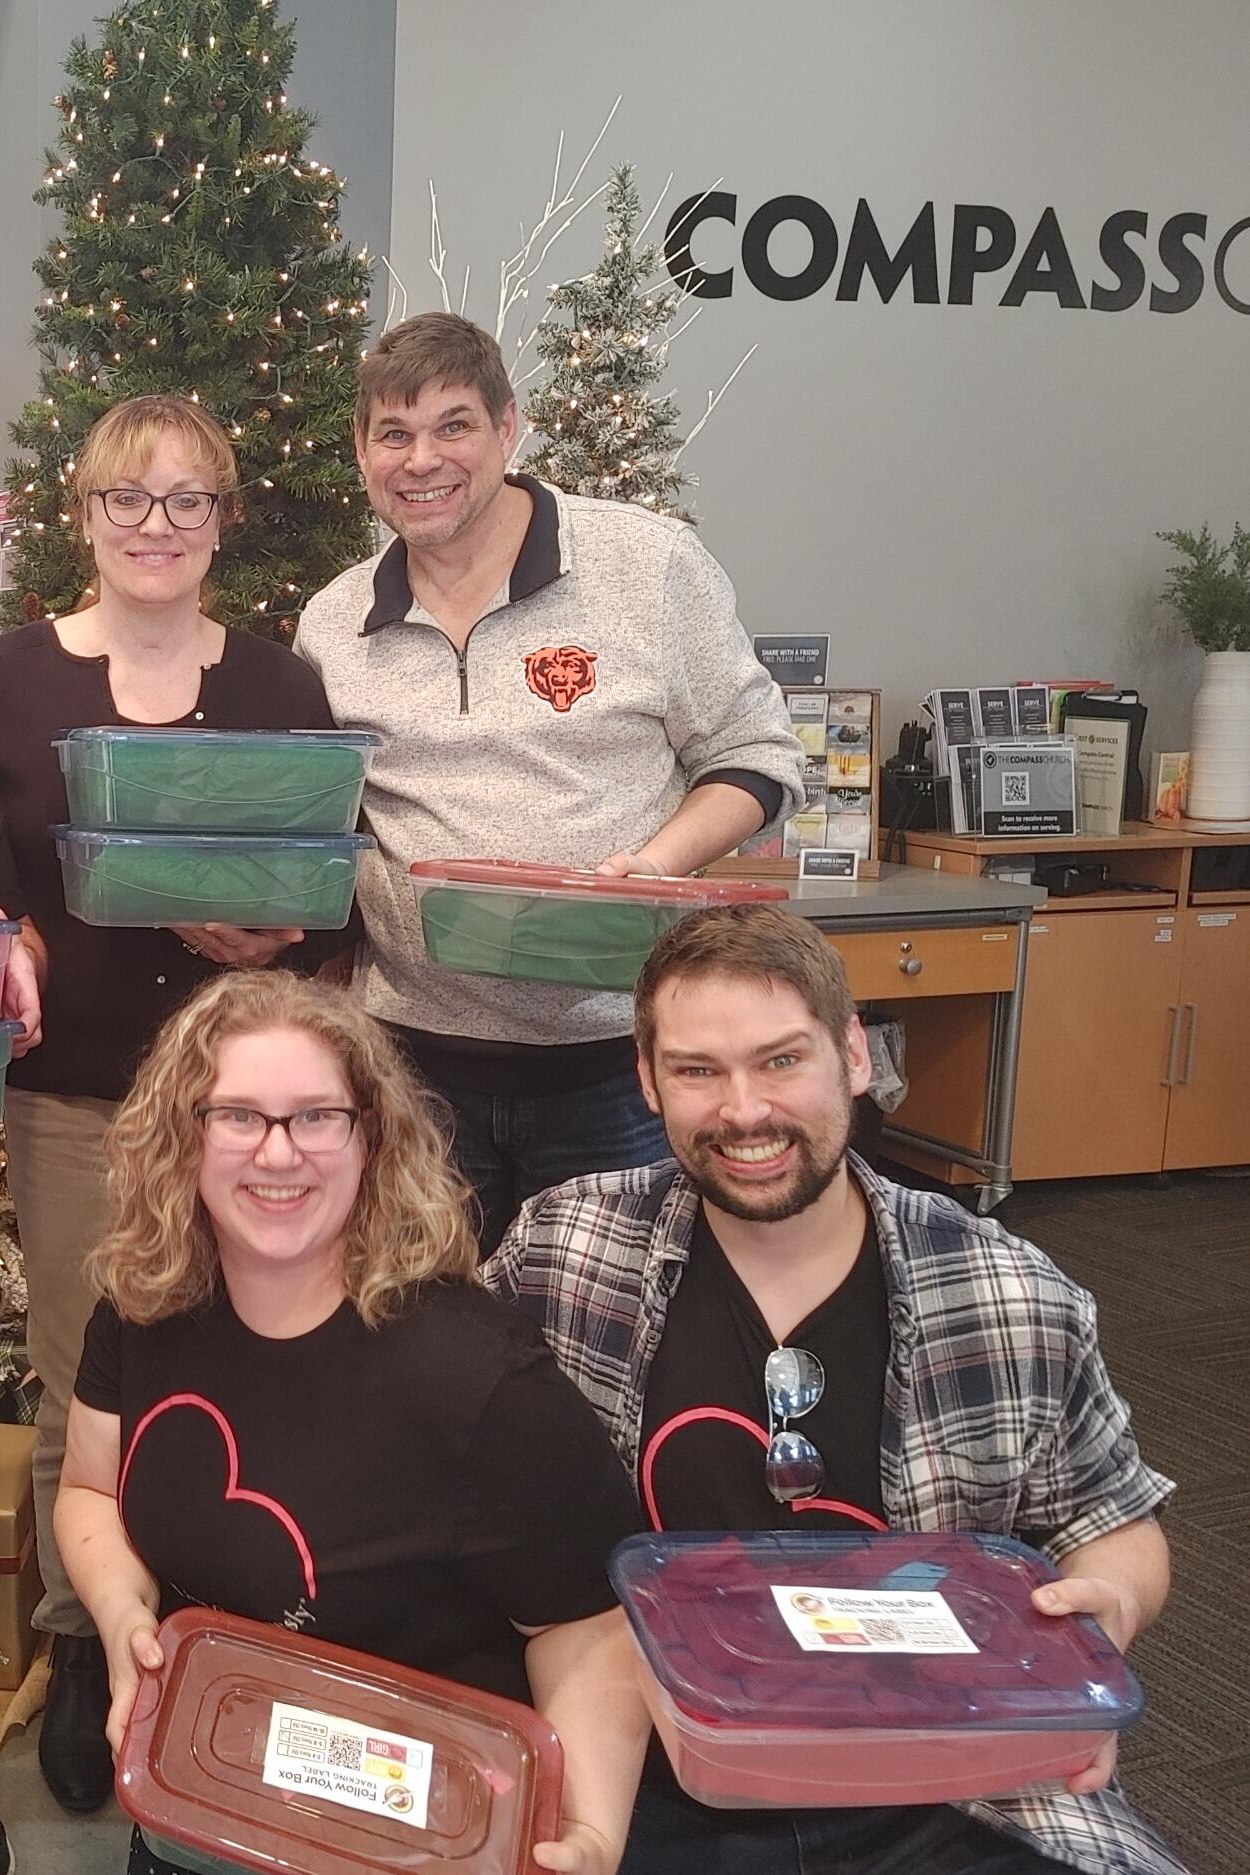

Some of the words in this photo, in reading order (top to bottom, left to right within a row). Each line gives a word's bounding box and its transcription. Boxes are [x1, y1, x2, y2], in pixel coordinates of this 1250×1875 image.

[827, 1597, 874, 1608] Follow
[875, 1598, 906, 1608] Your
[907, 1599, 935, 1608] Box
[369, 1742, 390, 1756] GIRL
[278, 1769, 303, 1783] Box
[301, 1765, 330, 1778] LABEL
[304, 1776, 334, 1791] Your
[331, 1772, 377, 1789] TRACKING
[335, 1784, 377, 1802] Follow
